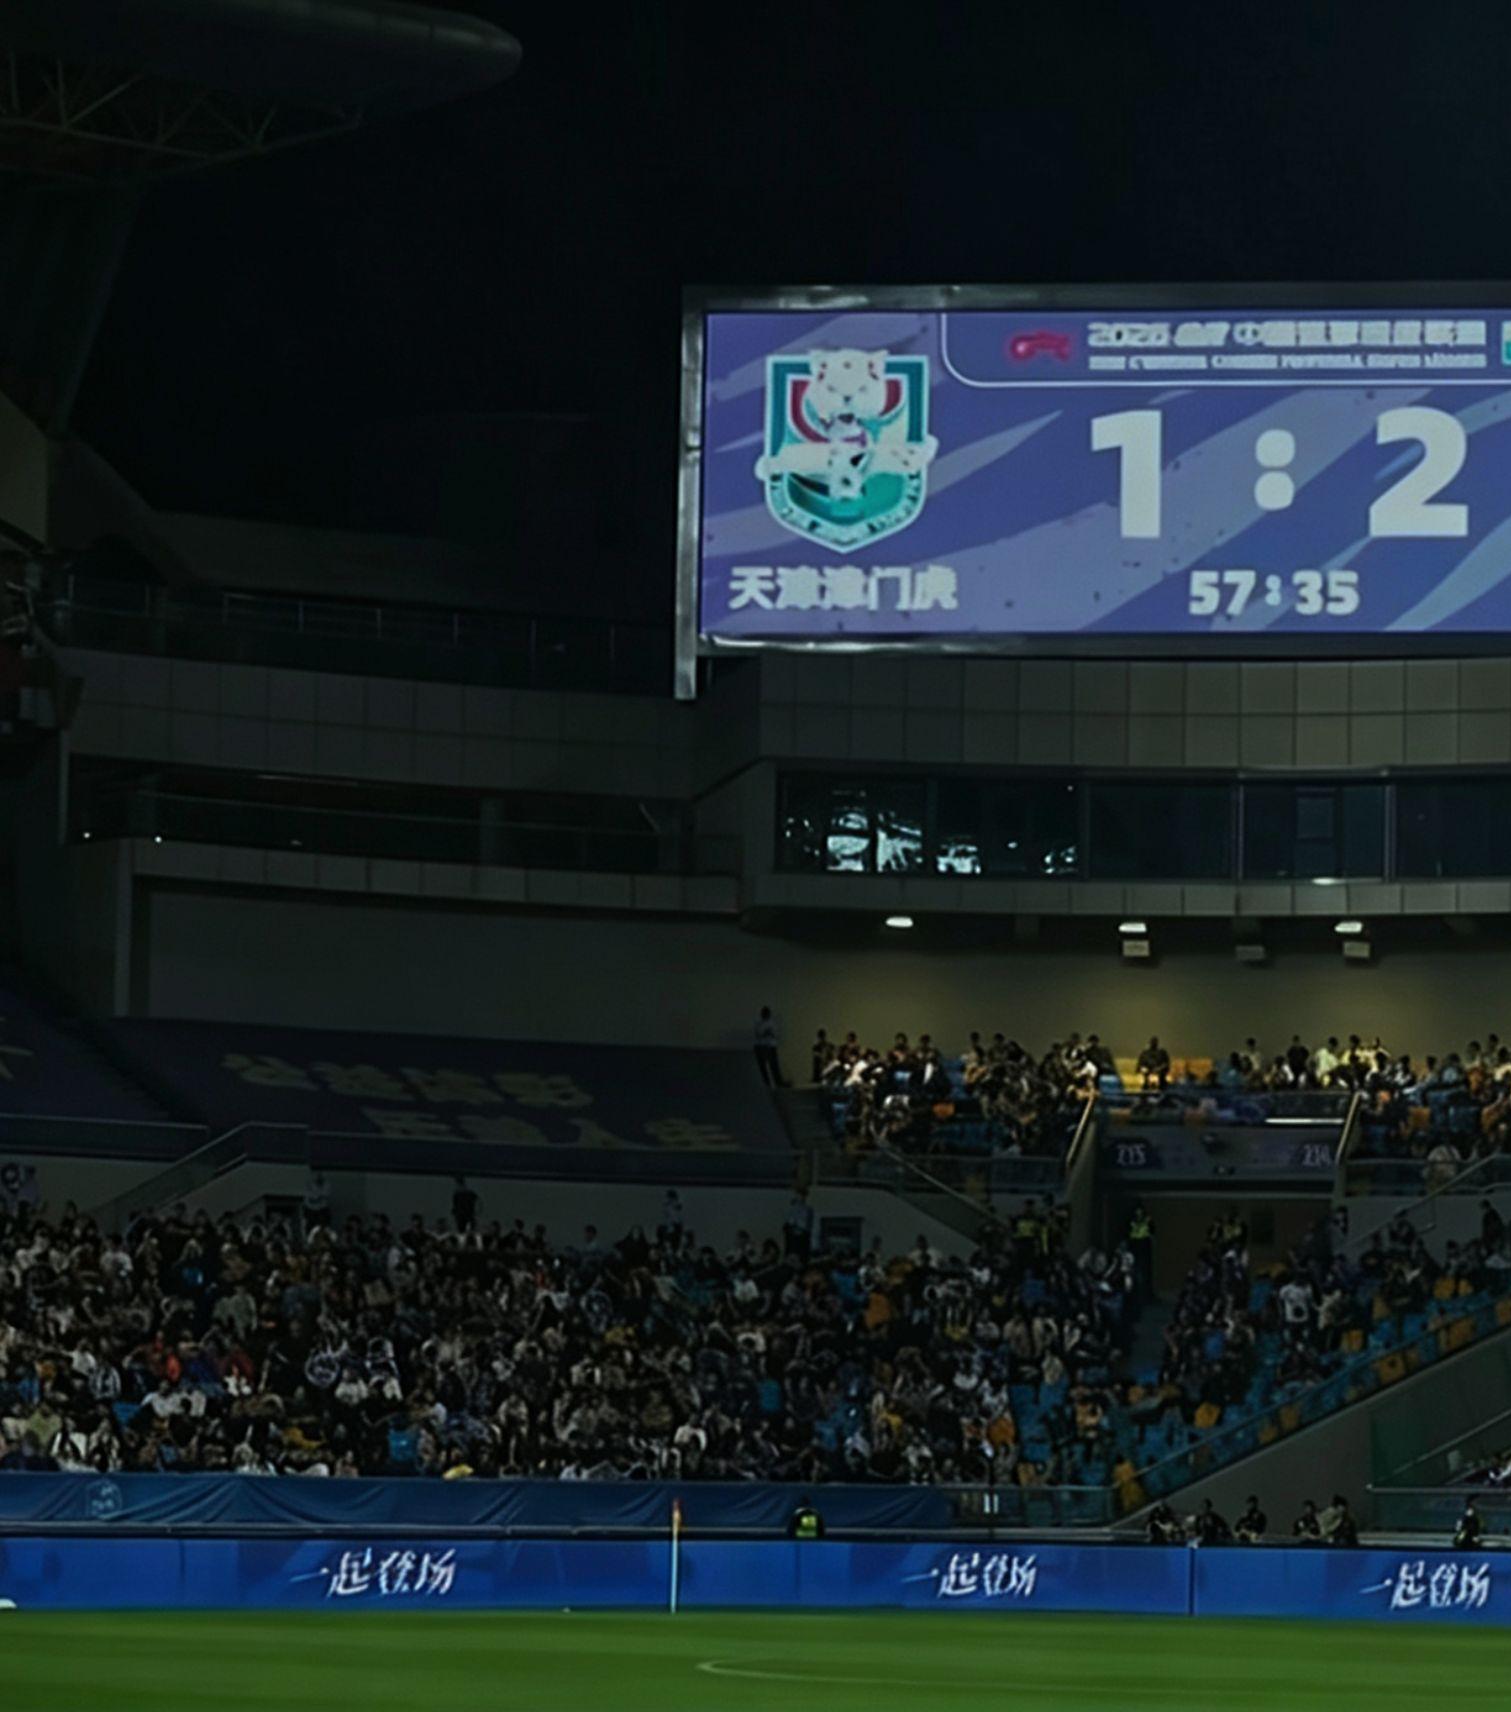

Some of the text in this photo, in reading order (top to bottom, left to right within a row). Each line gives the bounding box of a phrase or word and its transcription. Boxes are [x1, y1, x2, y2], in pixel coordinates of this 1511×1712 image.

[1091, 410, 1162, 538] 1
[1369, 406, 1469, 538] 2
[1189, 570, 1361, 616] 57:35
